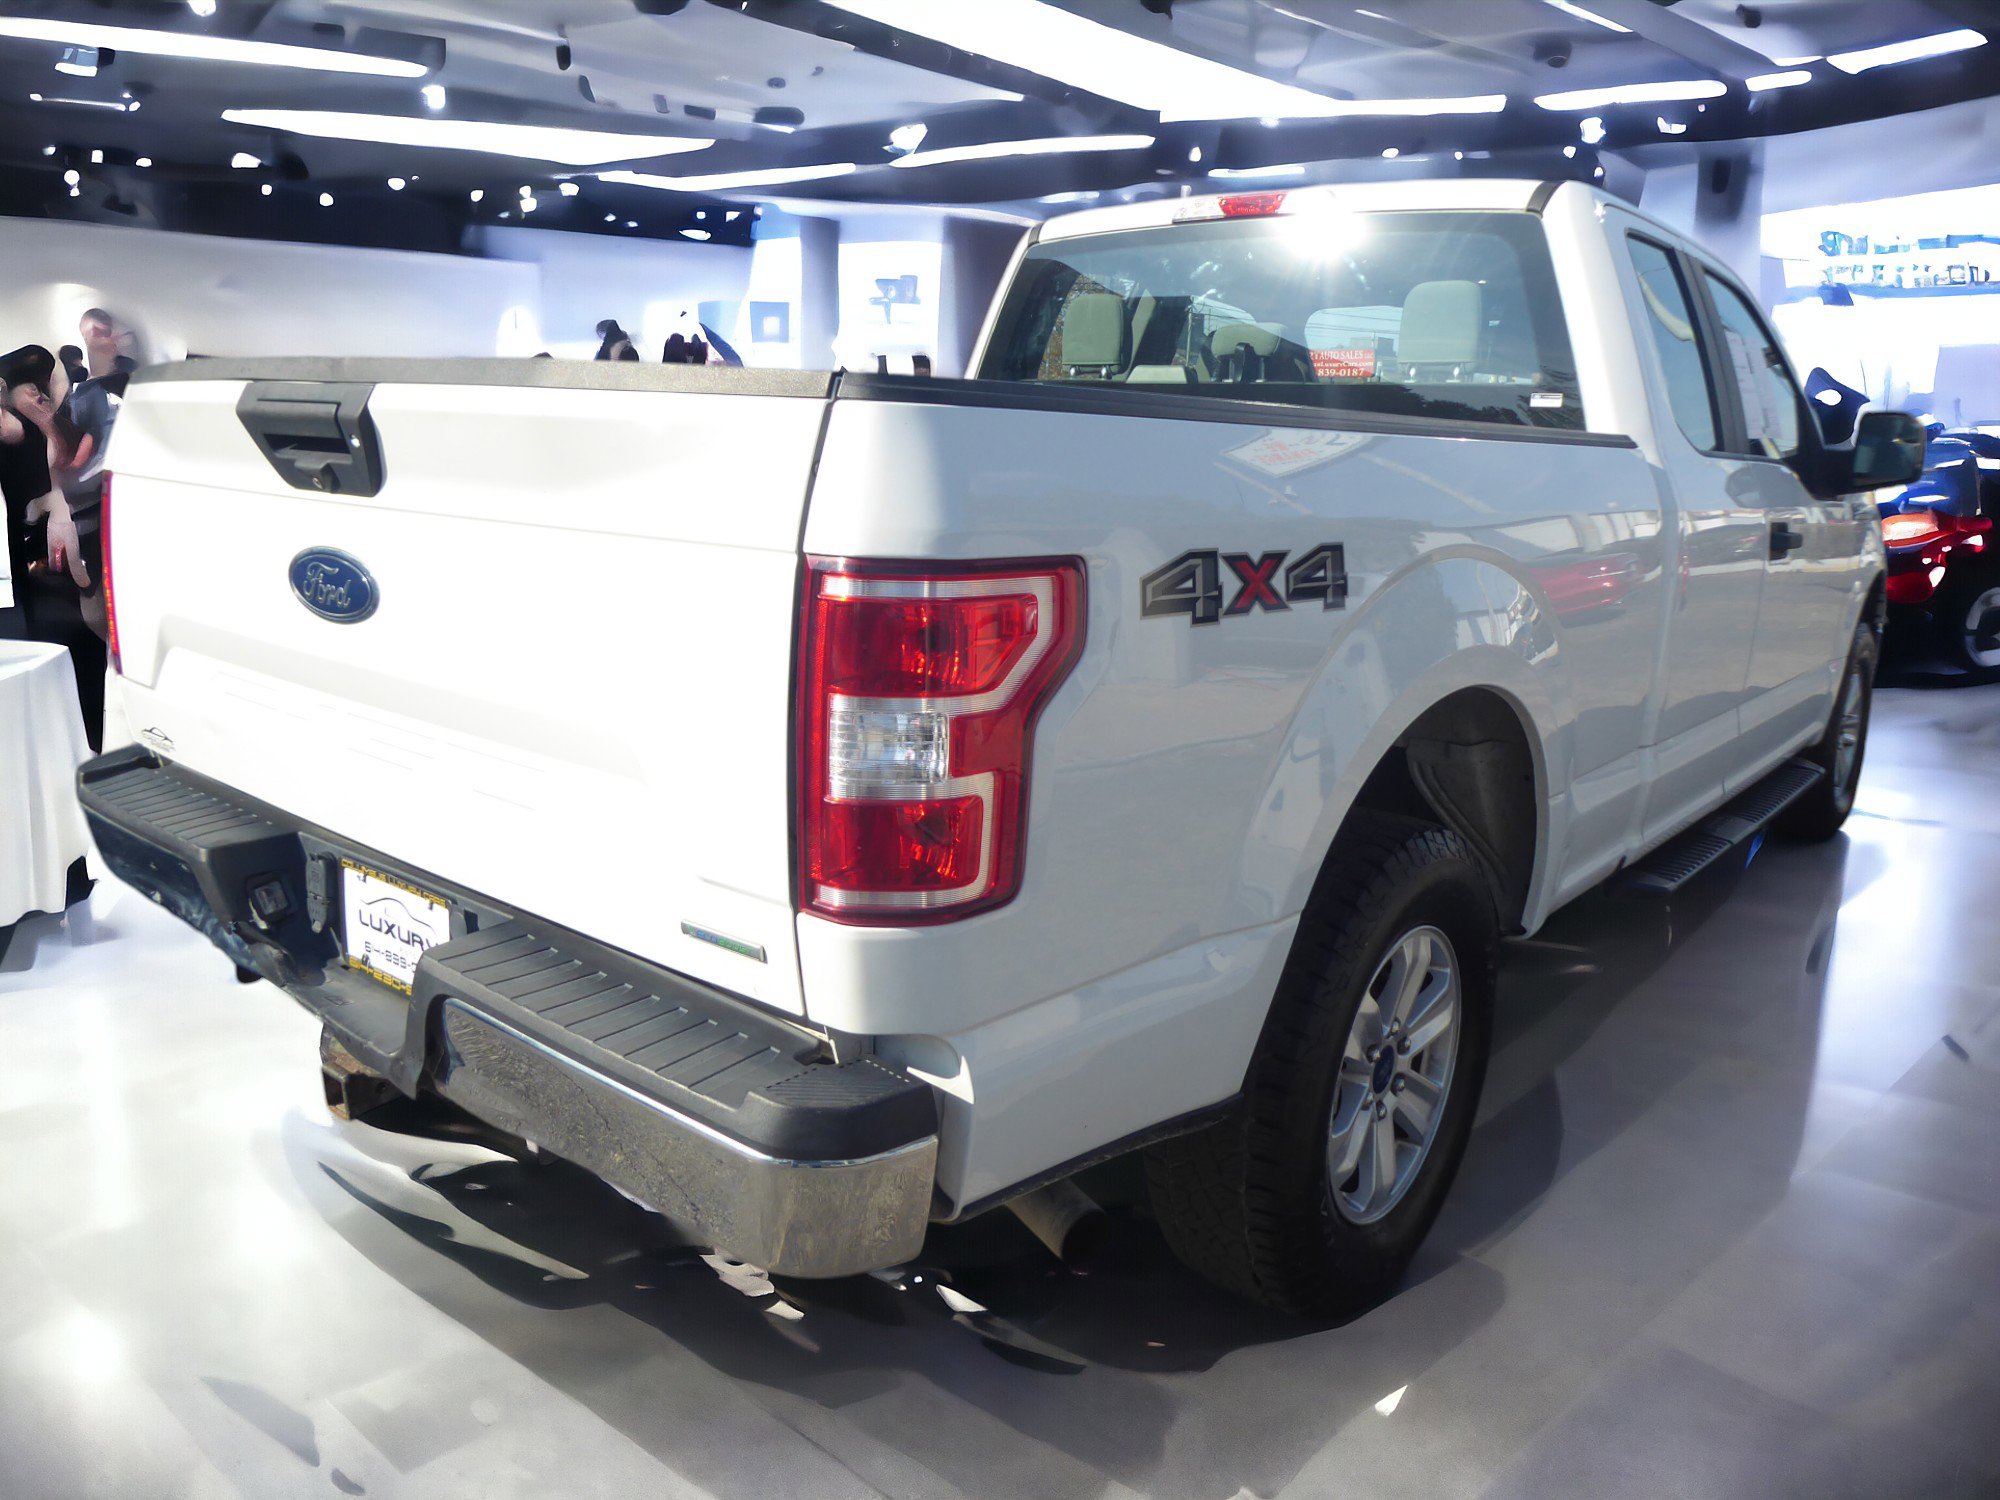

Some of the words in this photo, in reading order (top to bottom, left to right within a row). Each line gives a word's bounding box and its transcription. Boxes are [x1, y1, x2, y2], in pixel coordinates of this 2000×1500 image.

[1319, 350, 1340, 360] AUTO
[1341, 350, 1364, 360] SALES
[1318, 368, 1364, 377] 839-0187
[303, 561, 352, 608] Ford
